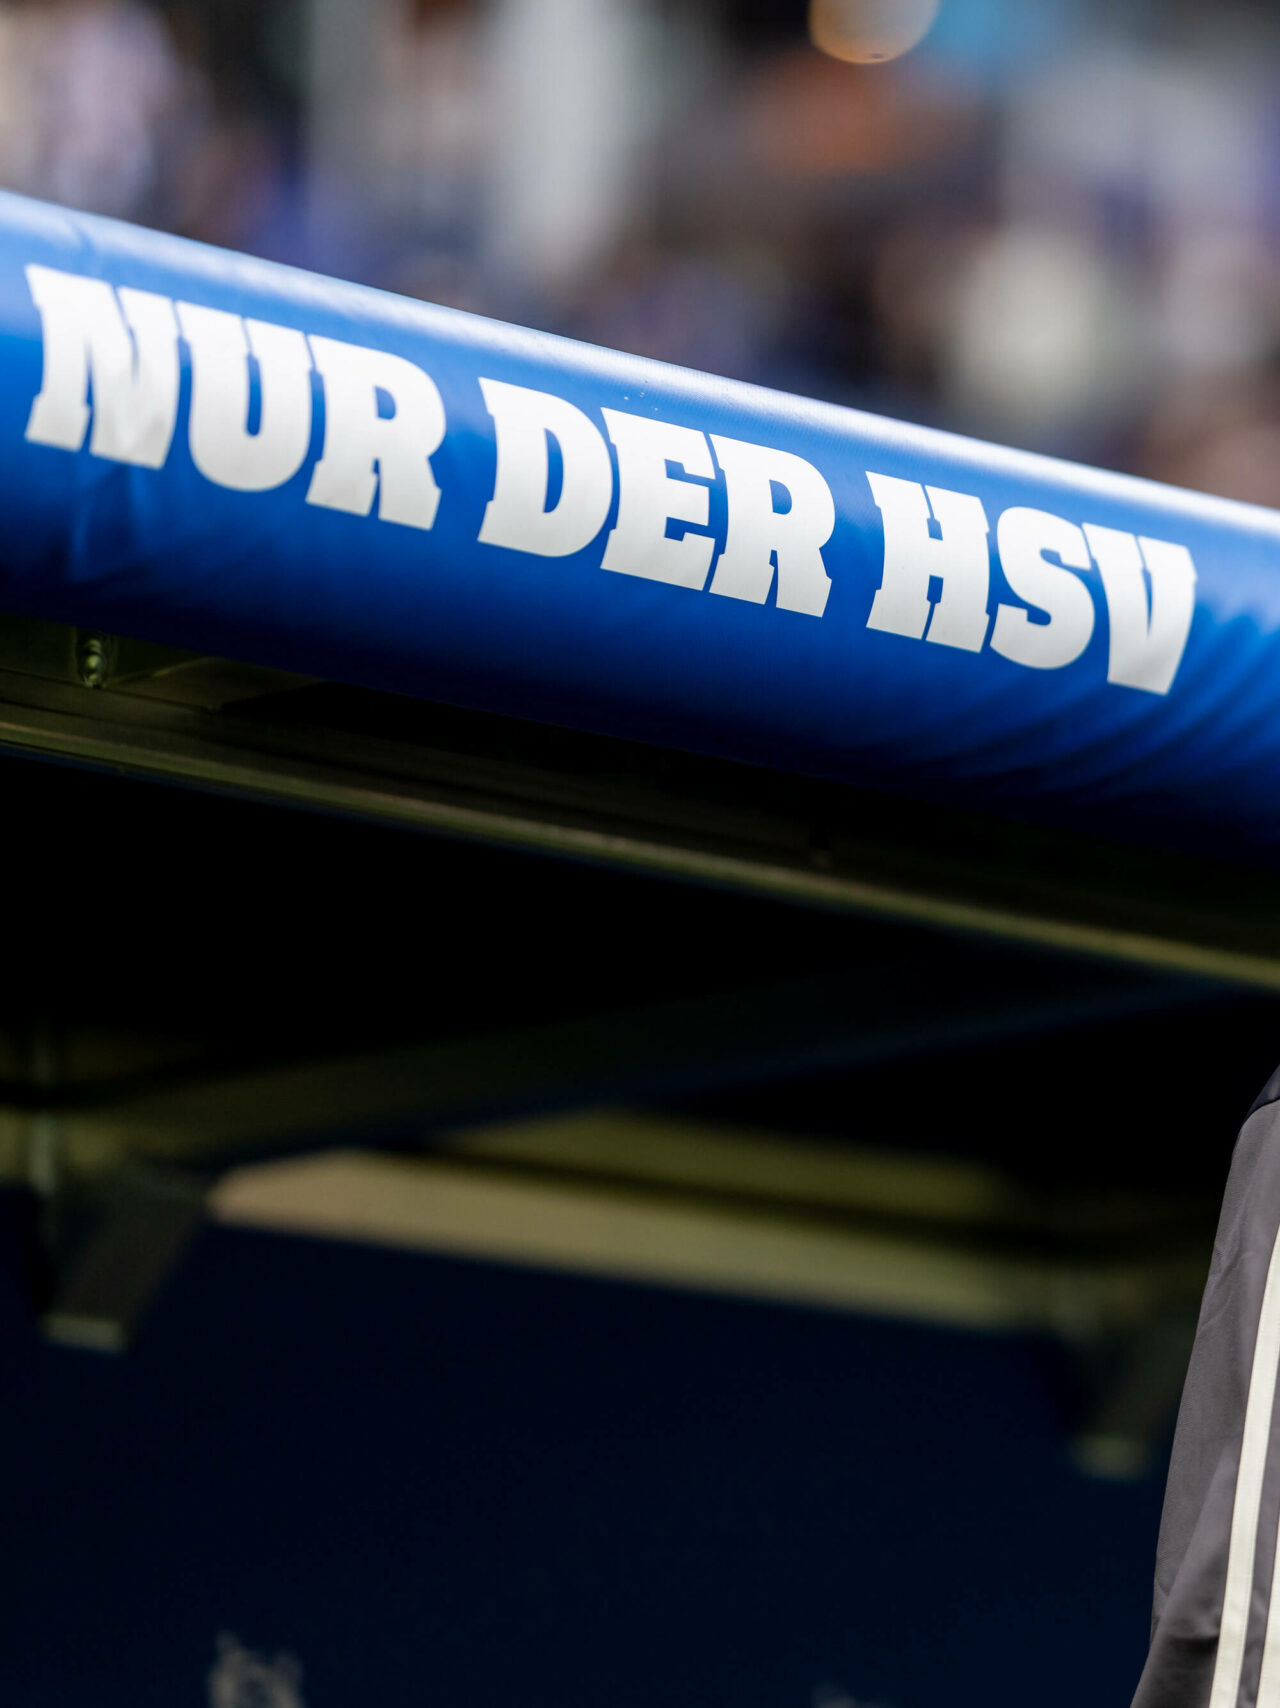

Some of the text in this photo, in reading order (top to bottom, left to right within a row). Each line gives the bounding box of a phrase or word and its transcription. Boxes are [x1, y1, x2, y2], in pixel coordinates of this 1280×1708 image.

[25, 263, 1197, 696] NUR DER HSV
